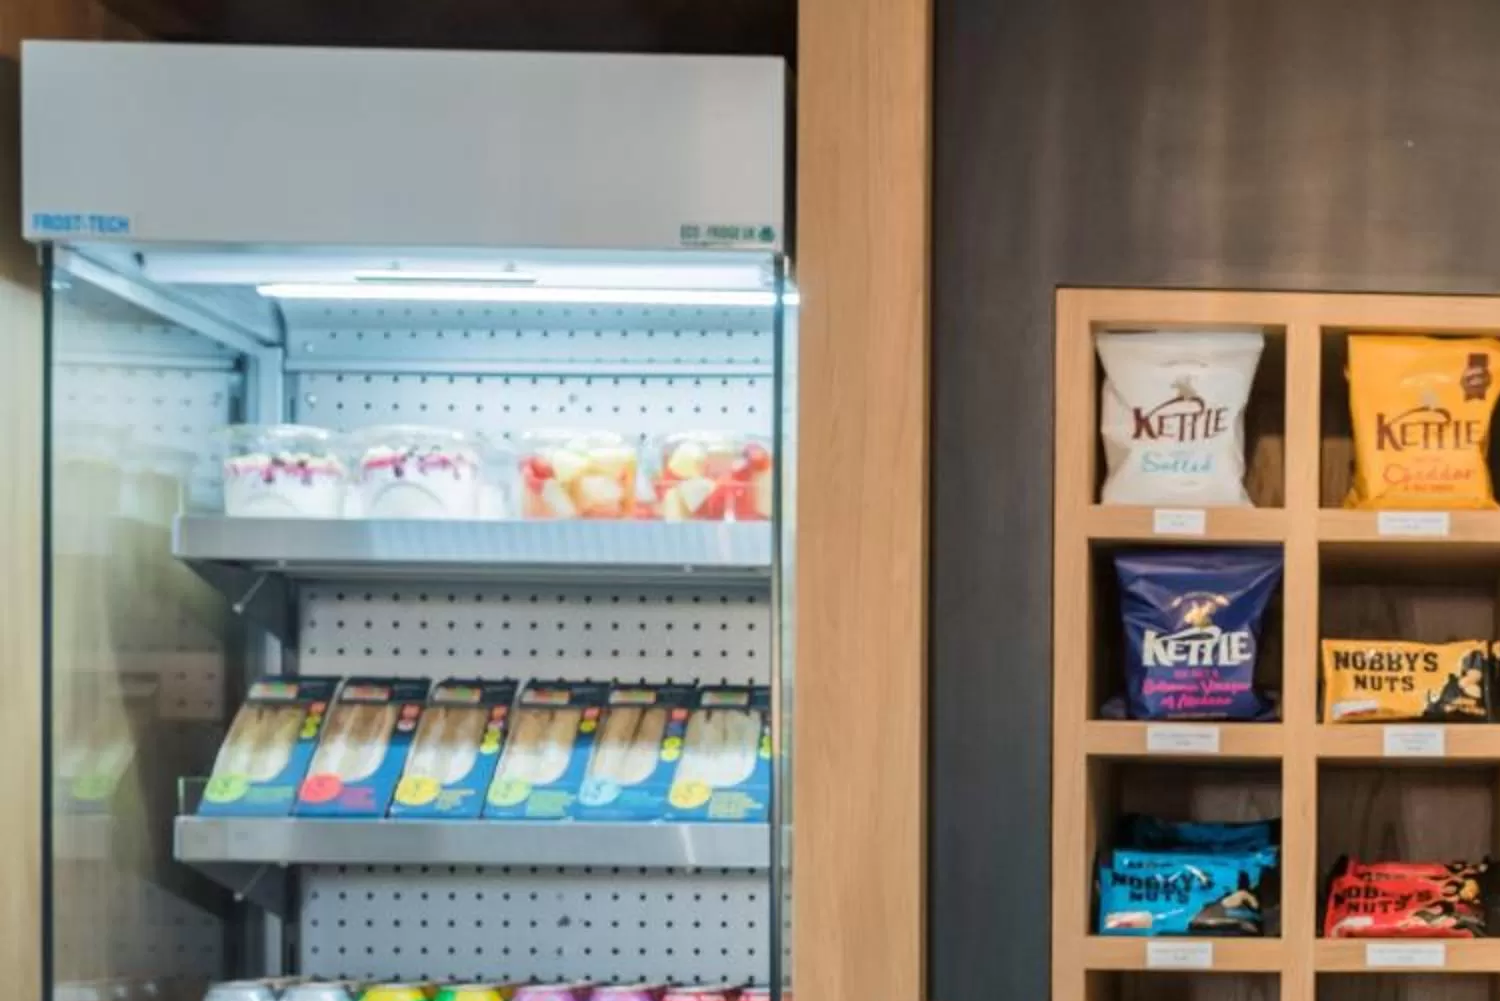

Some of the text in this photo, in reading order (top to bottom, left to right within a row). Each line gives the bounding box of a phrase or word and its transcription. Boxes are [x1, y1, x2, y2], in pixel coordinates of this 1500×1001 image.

[31, 212, 130, 233] FROST-TECH
[1132, 396, 1229, 441] KETTLE
[1376, 406, 1482, 452] KETTLE
[1142, 626, 1252, 667] KETTLE
[1353, 674, 1415, 693] NUTS
